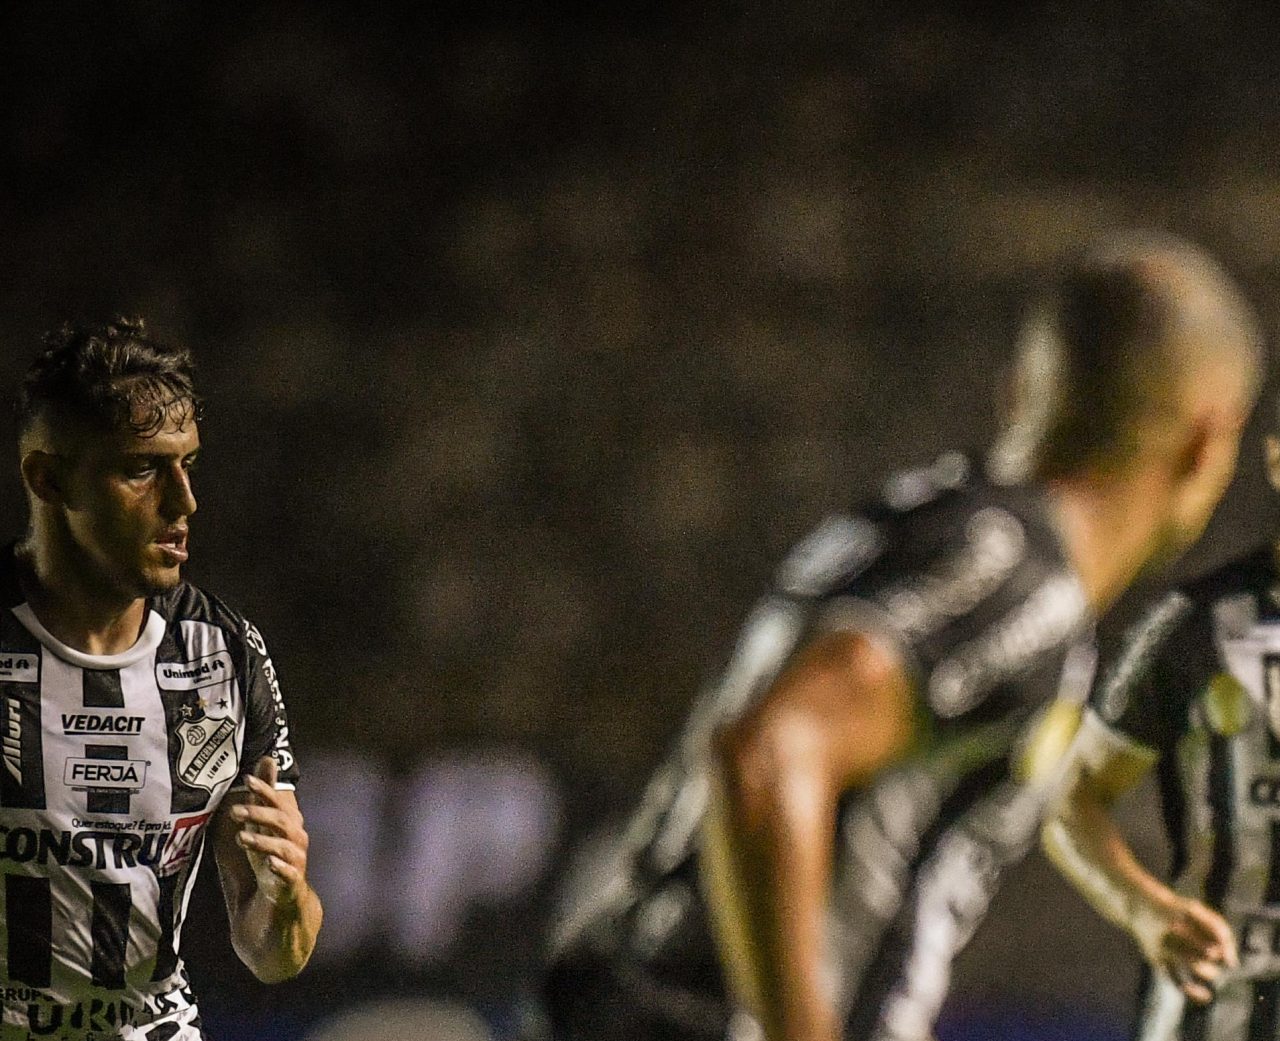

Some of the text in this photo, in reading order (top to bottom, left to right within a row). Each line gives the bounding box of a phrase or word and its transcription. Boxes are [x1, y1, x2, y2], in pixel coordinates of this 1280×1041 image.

[61, 713, 146, 734] VEDACIT
[193, 719, 236, 767] INTERNACIONAL
[71, 762, 139, 783] FERJÁ
[206, 750, 230, 779] LIMEIRA
